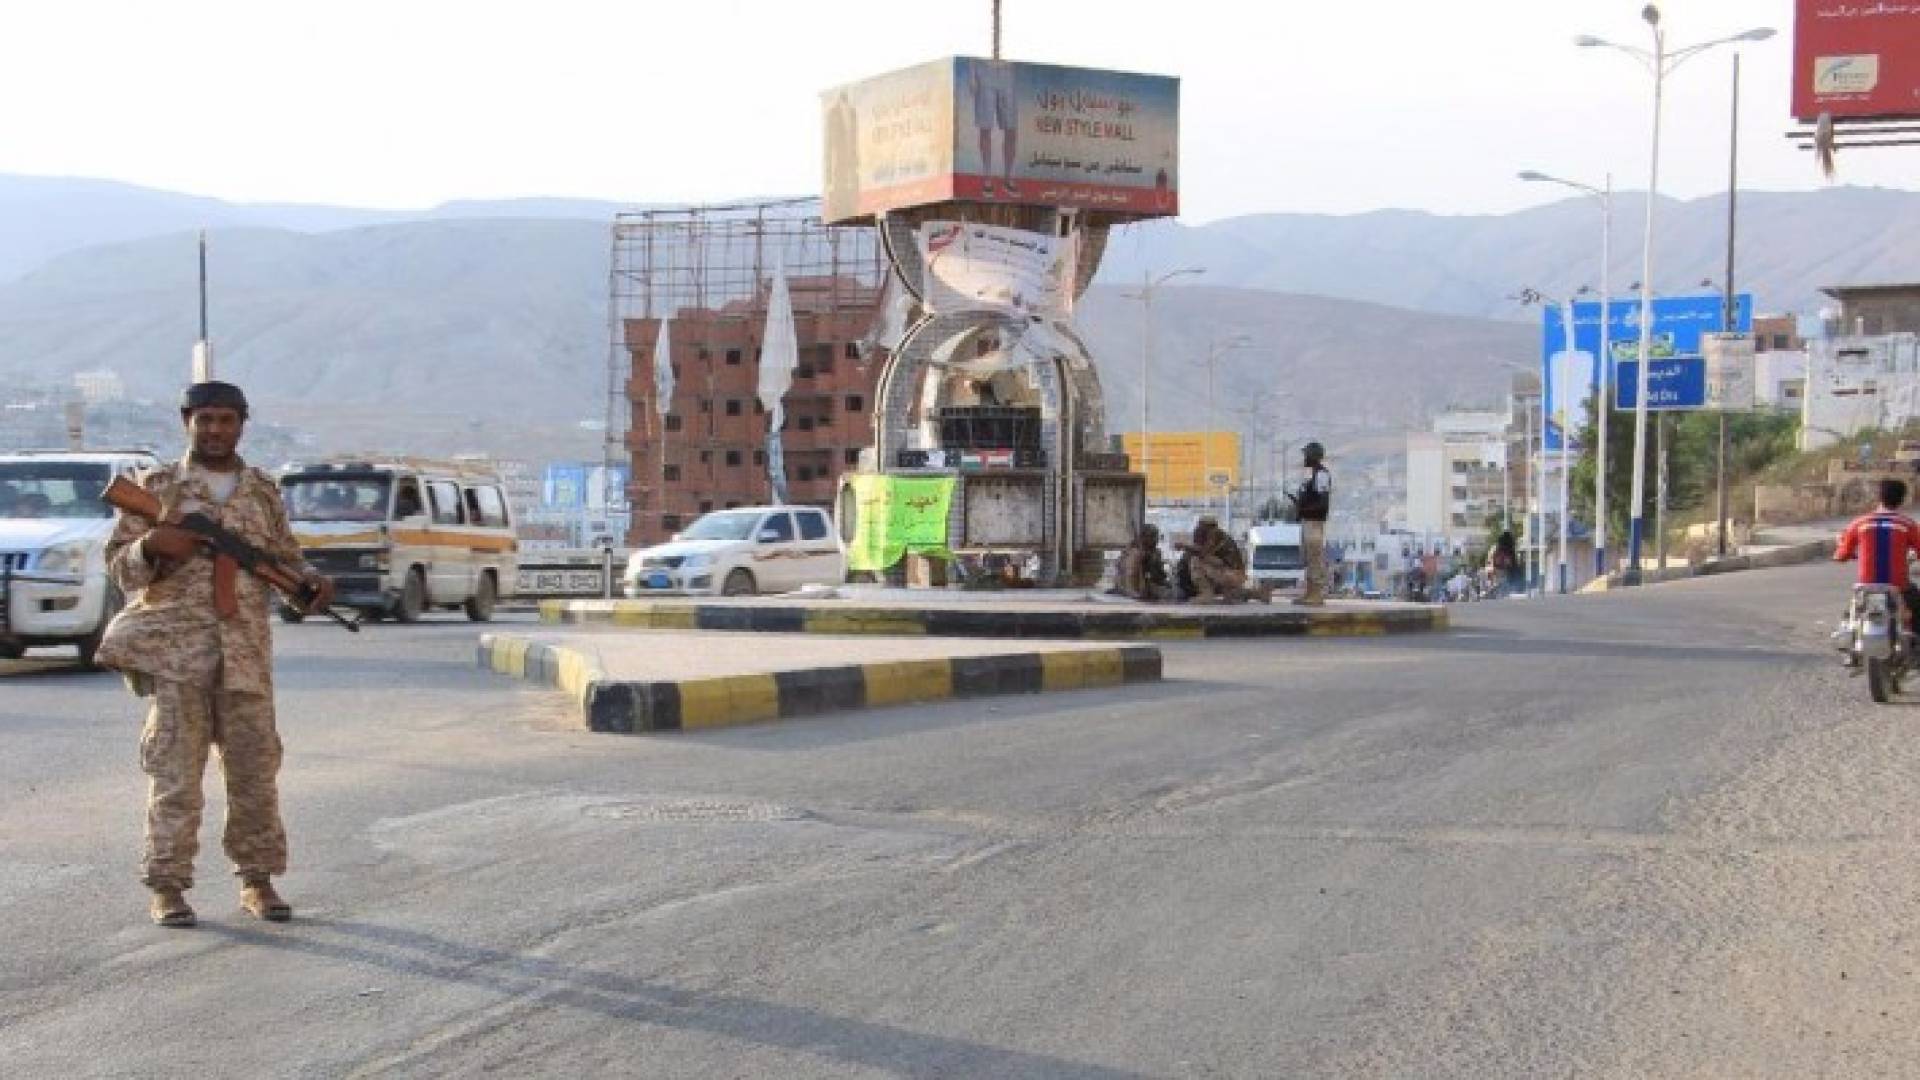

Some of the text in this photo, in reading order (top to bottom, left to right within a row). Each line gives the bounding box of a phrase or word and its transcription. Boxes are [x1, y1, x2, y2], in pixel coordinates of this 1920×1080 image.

[1035, 117, 1137, 141] NEW STYLE MALL
